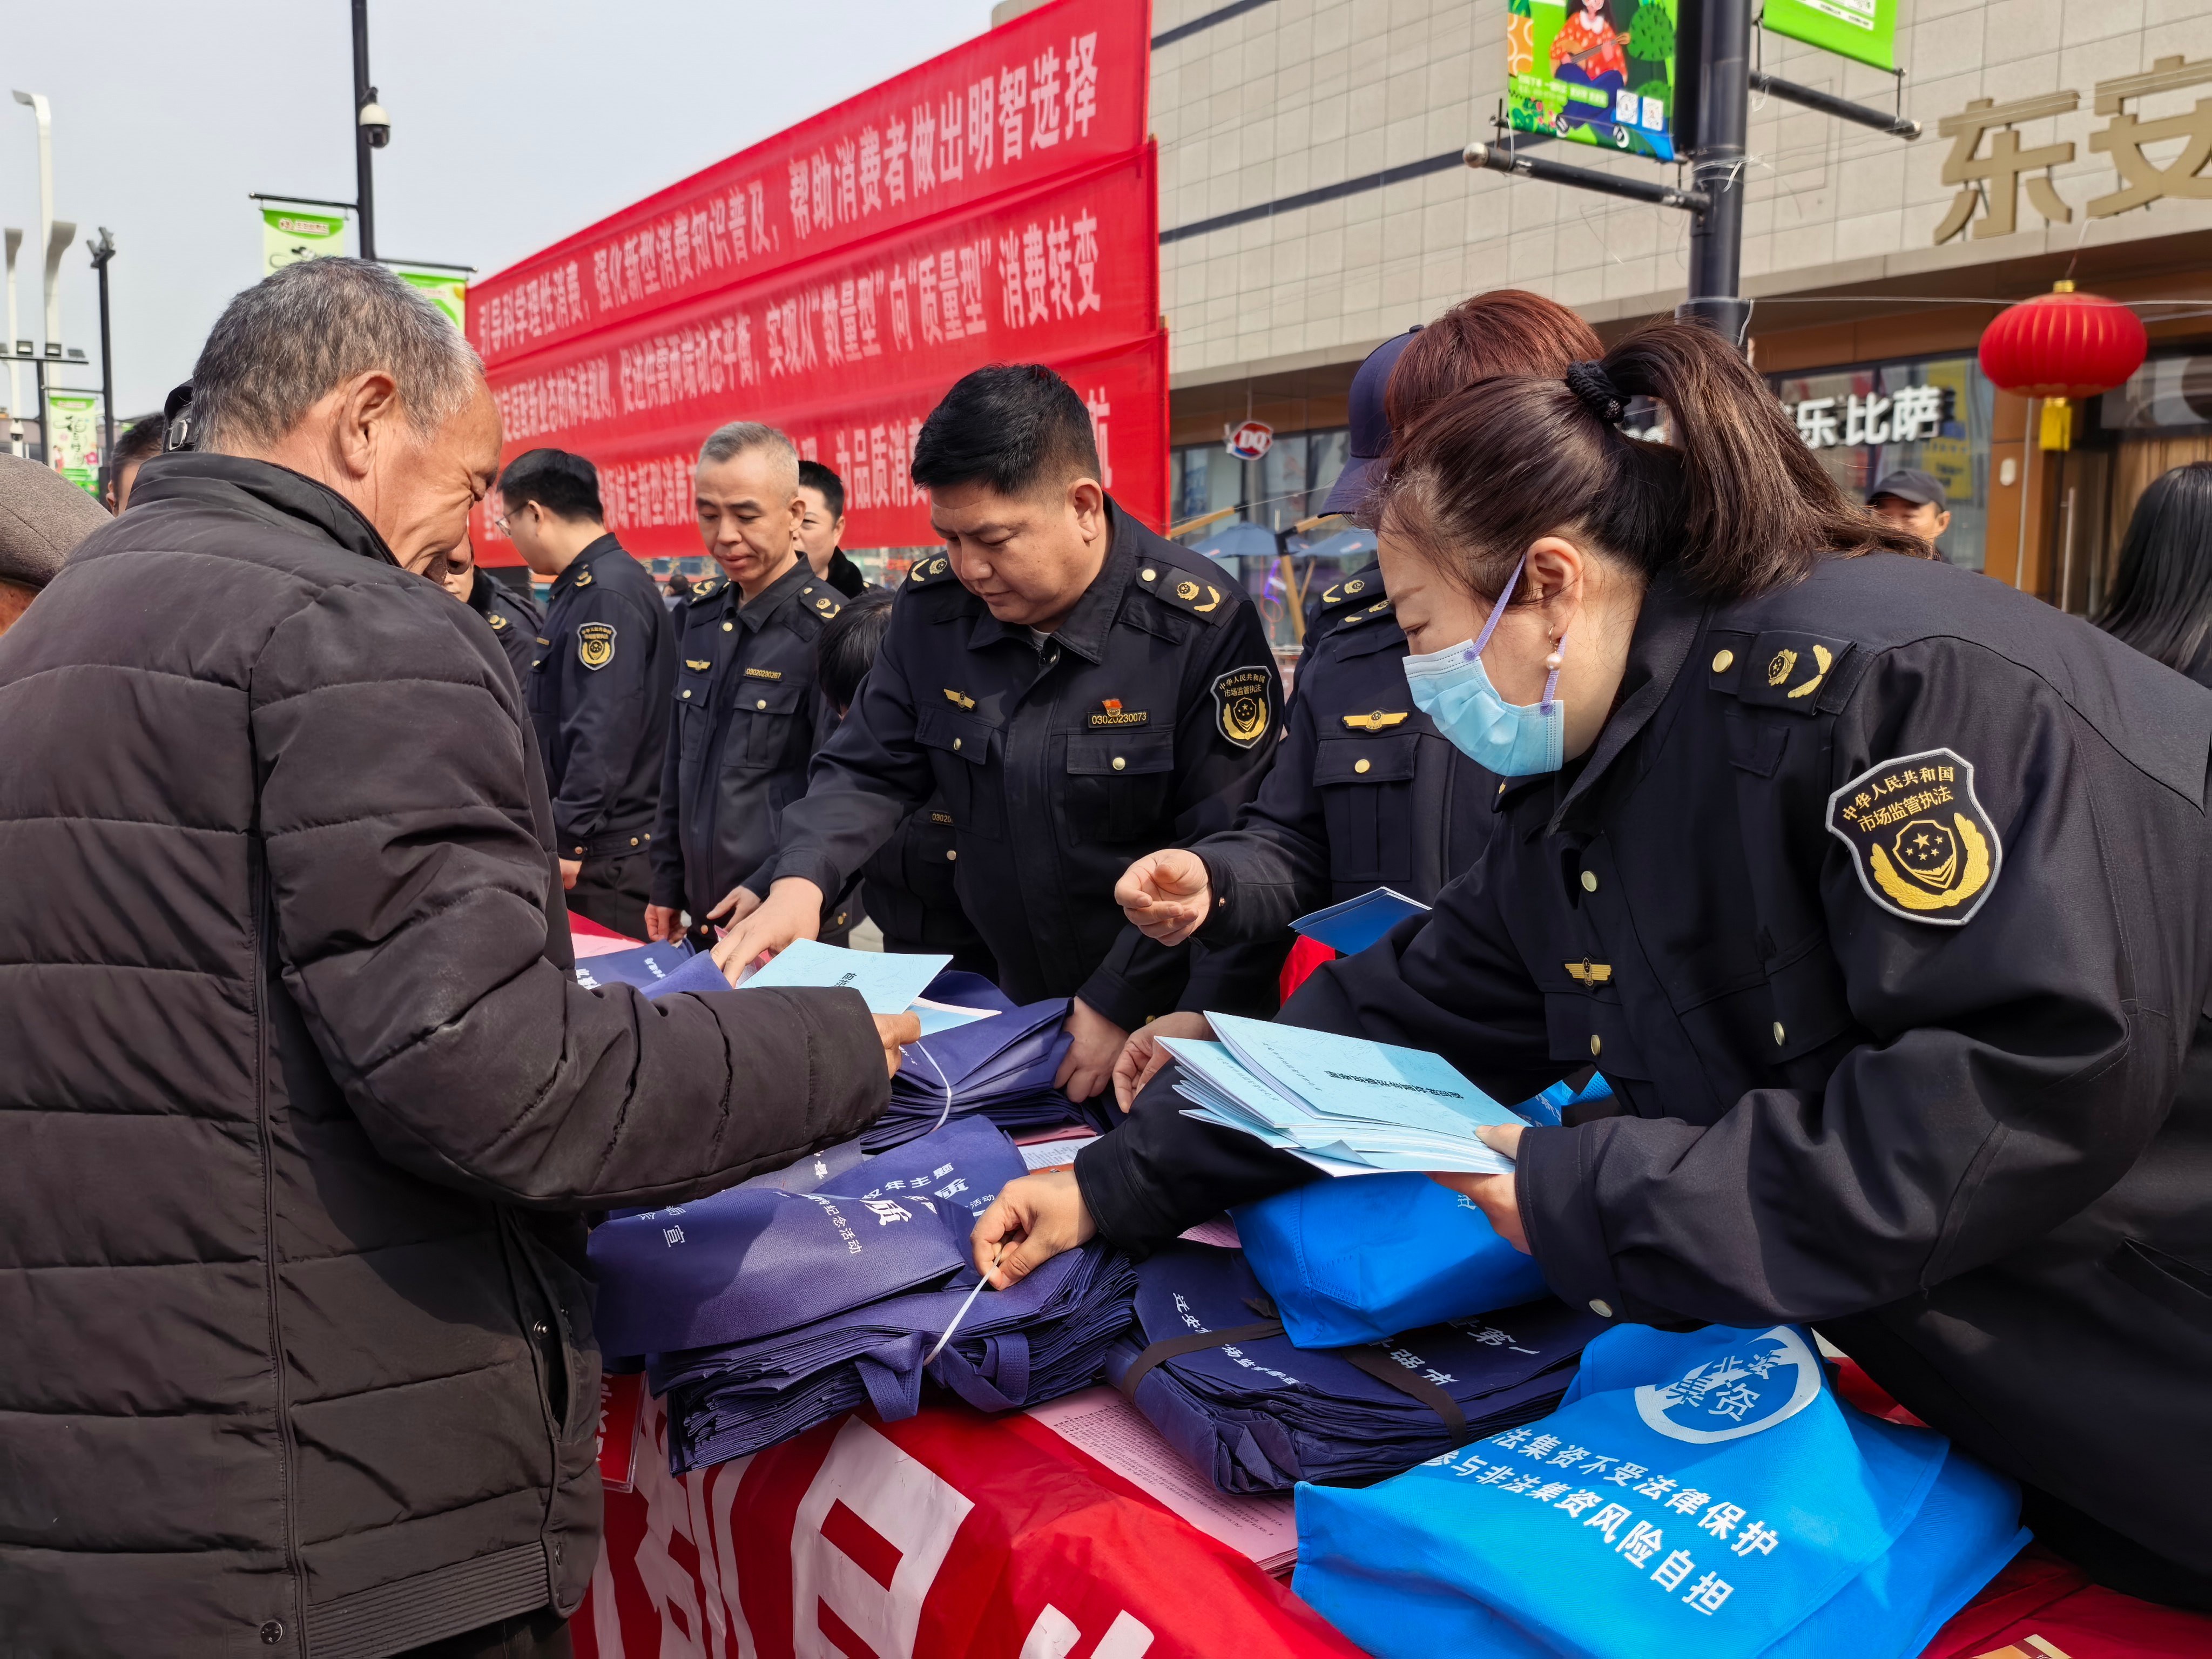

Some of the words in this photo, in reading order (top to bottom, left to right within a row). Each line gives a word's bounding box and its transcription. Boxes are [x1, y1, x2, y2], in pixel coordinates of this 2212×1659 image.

[1783, 385, 1941, 449] 乐比萨
[1239, 429, 1268, 452] DQ
[1219, 673, 1265, 690] 中华人民共和国
[1224, 684, 1262, 698] 市场监管执法
[1091, 712, 1147, 724] 03020230073
[1842, 766, 1954, 821] 中华人民共和国
[1857, 785, 1954, 832] 市场监管执法
[966, 1193, 995, 1209] 活动
[663, 1224, 685, 1247] 宣
[1486, 1428, 1779, 1557] 法集资不受法律保护
